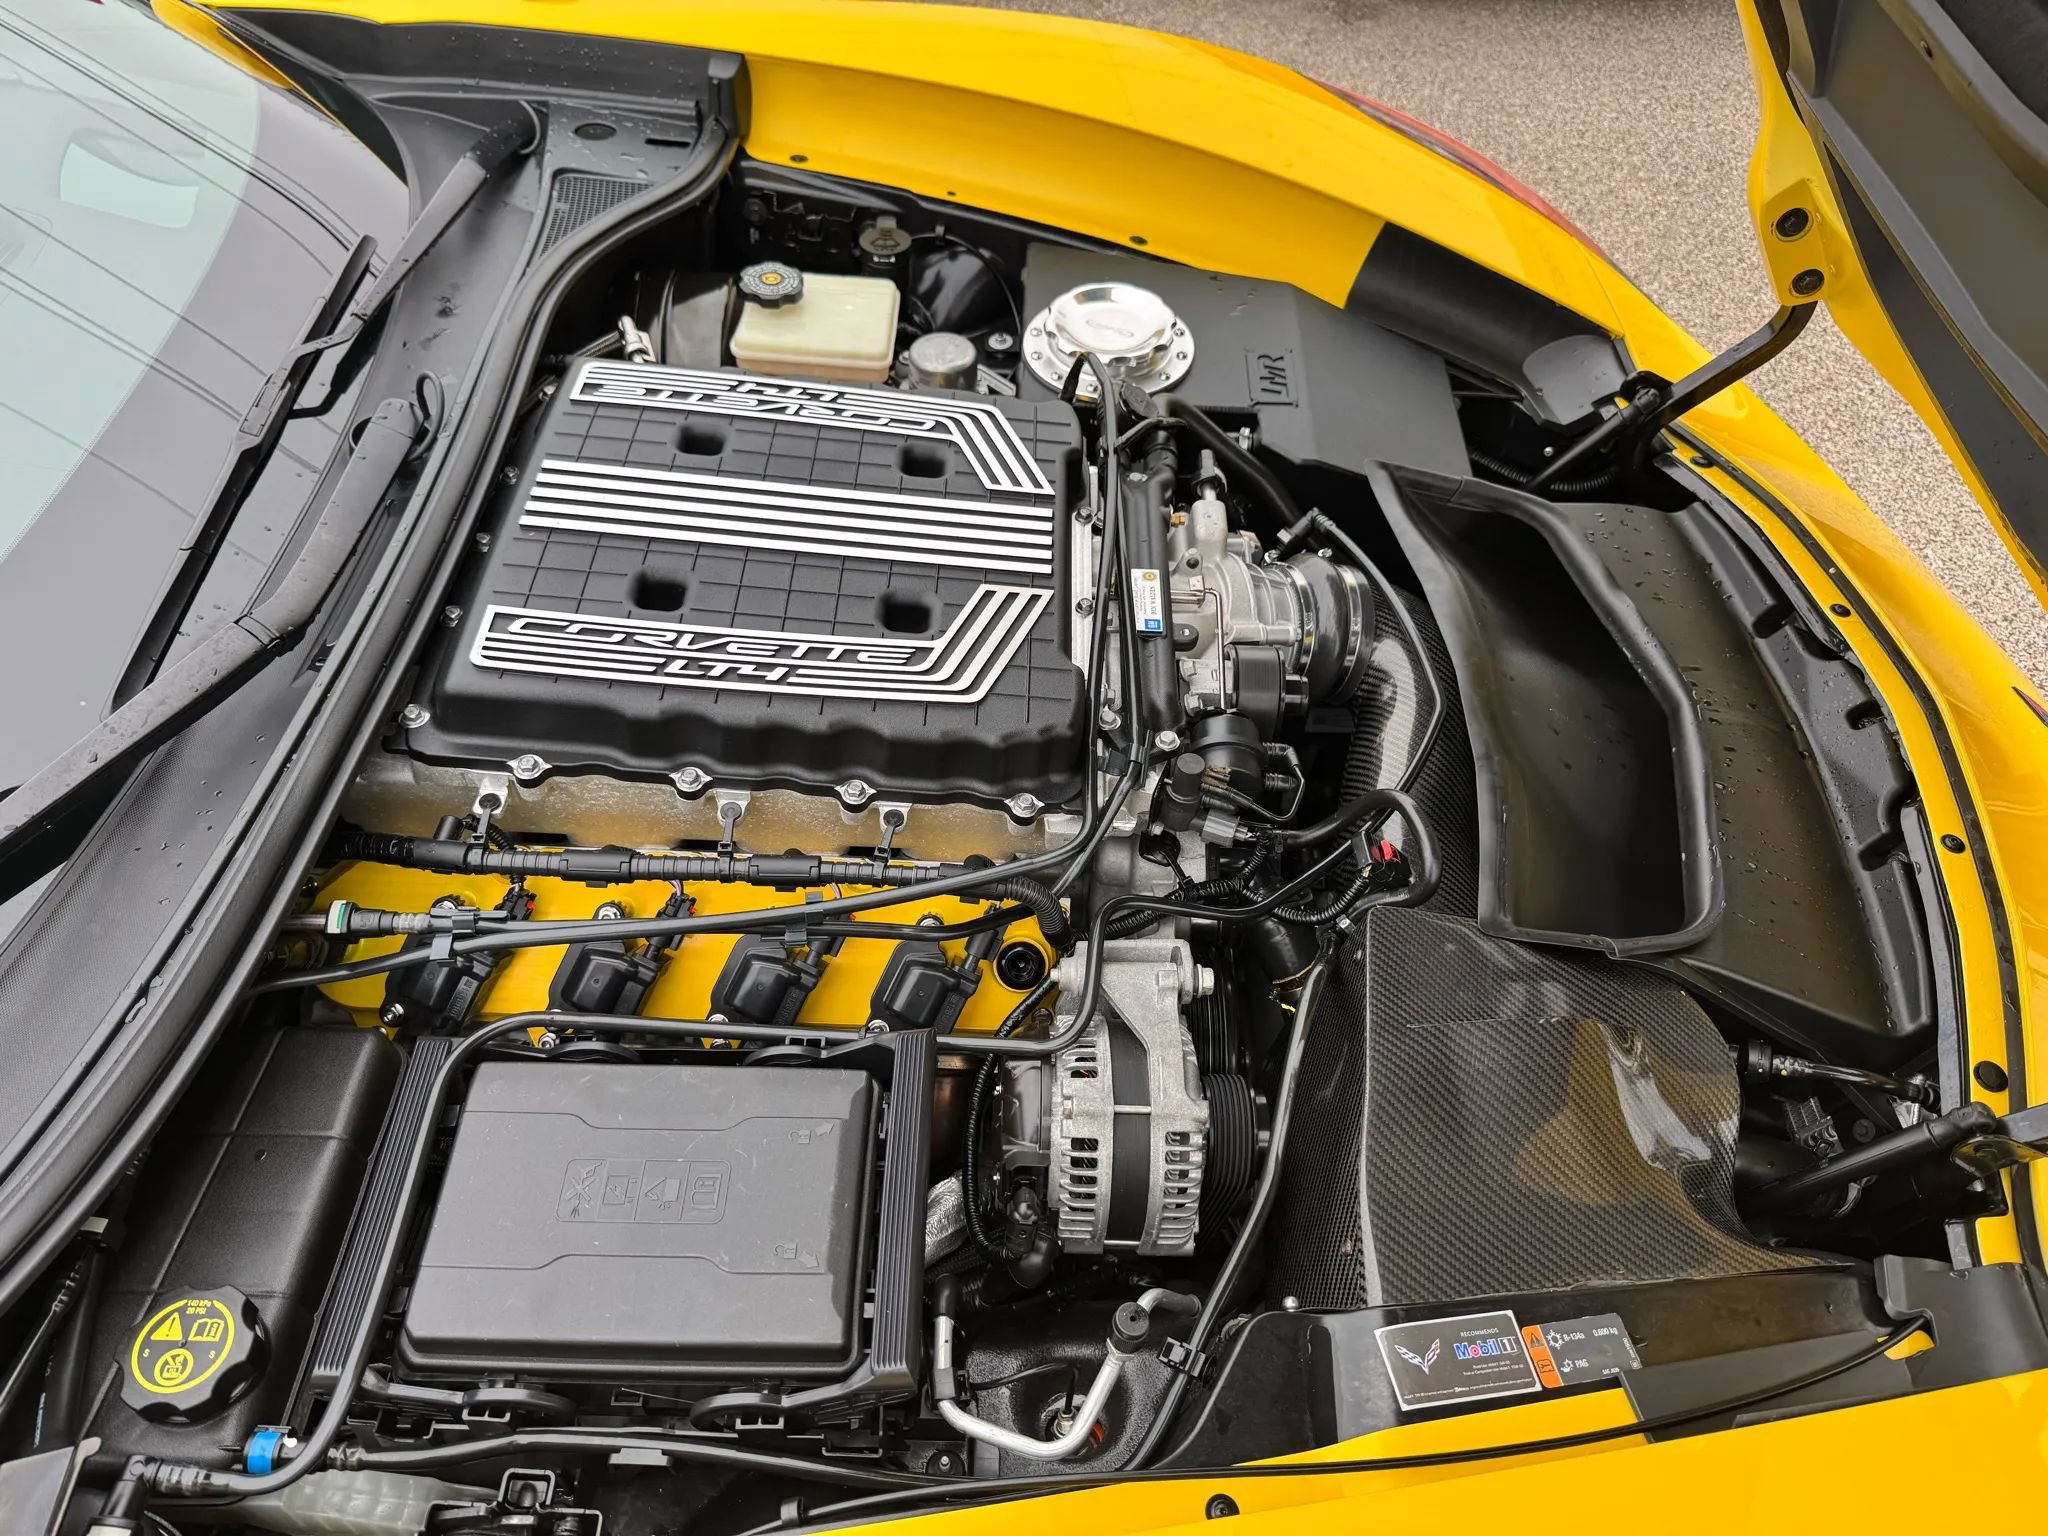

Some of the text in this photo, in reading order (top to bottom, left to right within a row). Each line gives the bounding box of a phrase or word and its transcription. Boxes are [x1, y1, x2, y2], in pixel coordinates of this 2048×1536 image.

[735, 381, 840, 402] LT4
[592, 384, 937, 432] CORVETTE
[508, 616, 917, 665] CORVETTE
[663, 658, 790, 682] LT4
[1460, 1327, 1499, 1338] RECOMMENDS
[1453, 1338, 1500, 1360] Mobil
[1575, 1358, 1589, 1368] PAG
